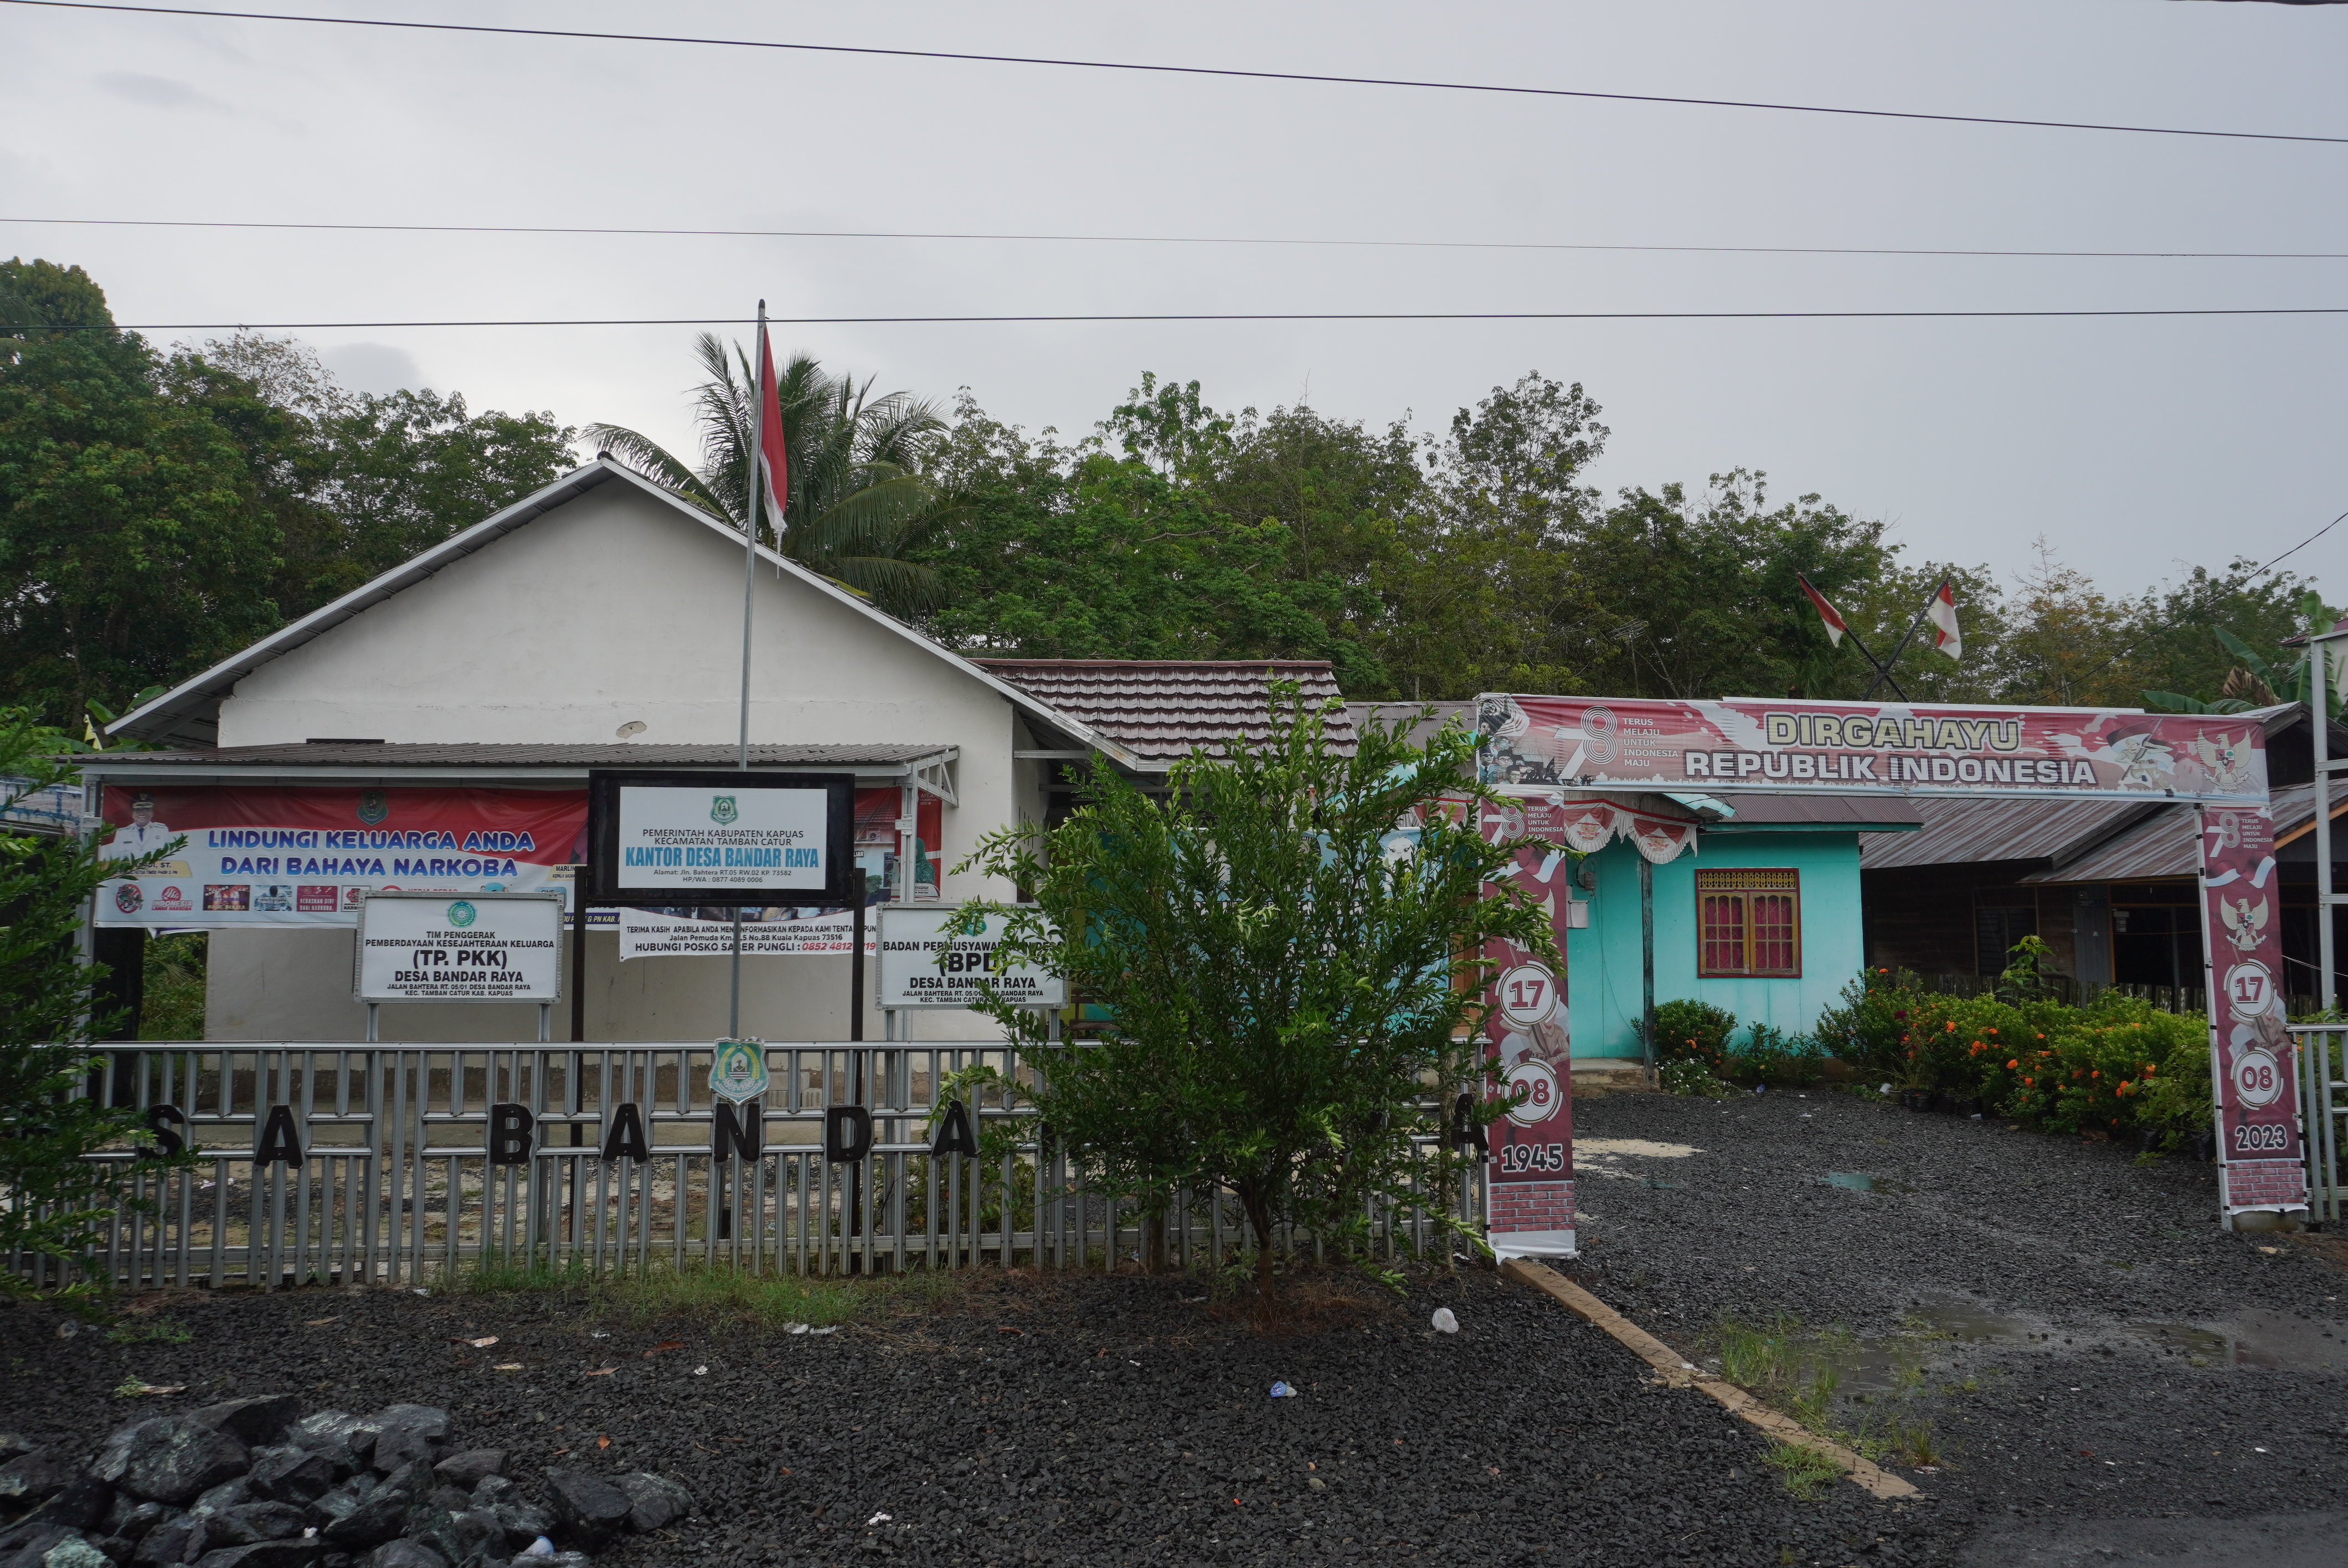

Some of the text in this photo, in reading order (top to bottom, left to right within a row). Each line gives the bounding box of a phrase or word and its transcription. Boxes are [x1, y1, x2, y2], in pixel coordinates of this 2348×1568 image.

[1767, 714, 2019, 750] DIRGAHAYU
[1685, 751, 2098, 785] REPUBLIK INDONESIA
[208, 830, 534, 851] LINDUNGI KELUARGA ANDA
[643, 829, 704, 837] PEMERINTAH
[220, 857, 518, 877] DARI BAHAYA NARKOBA
[625, 847, 819, 868] KANTOR DESA BANDAR RAYA
[635, 943, 681, 951] HUBUNGI
[684, 943, 718, 951] POSKO
[721, 942, 754, 951] SAER
[802, 942, 827, 951] 0852
[829, 942, 853, 951] 4812
[883, 942, 920, 951] BADAN
[413, 950, 507, 969] (TP. PKK)
[395, 971, 523, 982] DESA BANDAR RAYA
[910, 977, 944, 988] DESA
[1003, 977, 1036, 988] RAYA
[1510, 980, 1545, 1010] 17
[2235, 976, 2264, 1003] 17
[2241, 1066, 2273, 1091] 08
[1510, 1079, 1550, 1107] 08
[2235, 1125, 2288, 1151] 2023
[1501, 1143, 1564, 1173] 1945
